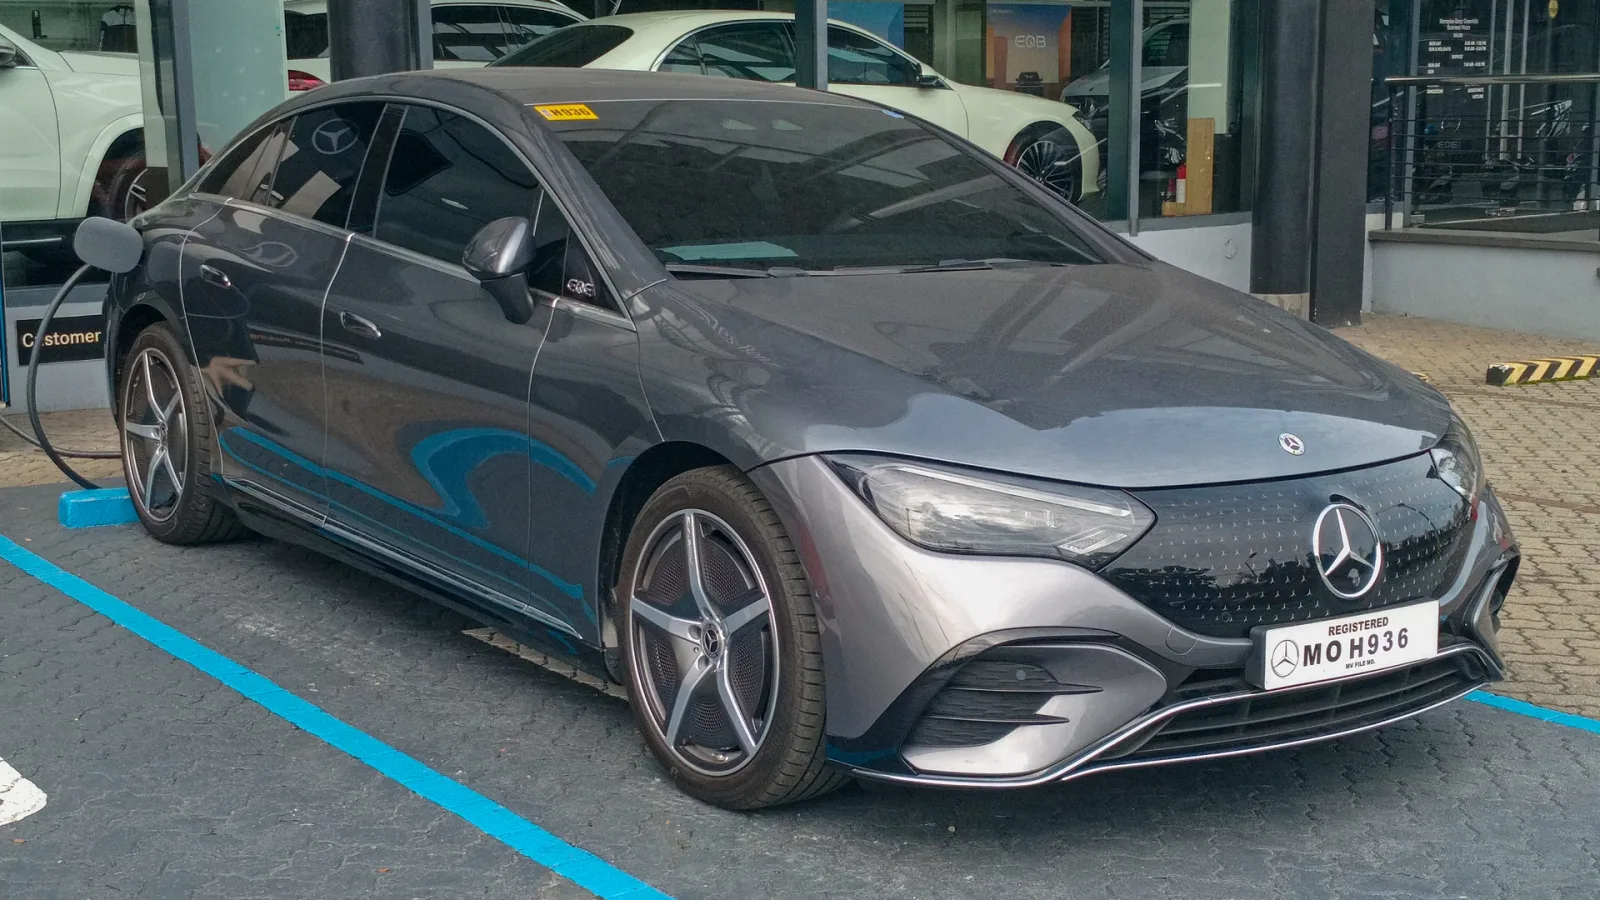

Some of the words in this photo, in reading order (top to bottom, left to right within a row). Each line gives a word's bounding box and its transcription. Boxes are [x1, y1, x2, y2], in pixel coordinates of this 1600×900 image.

[1014, 34, 1047, 49] EQB
[567, 278, 594, 298] EQE
[22, 330, 102, 348] Cstomer
[1328, 616, 1389, 637] REGISTERED
[1303, 639, 1342, 667] MO
[1349, 627, 1408, 660] H936
[1354, 660, 1366, 668] FILE
